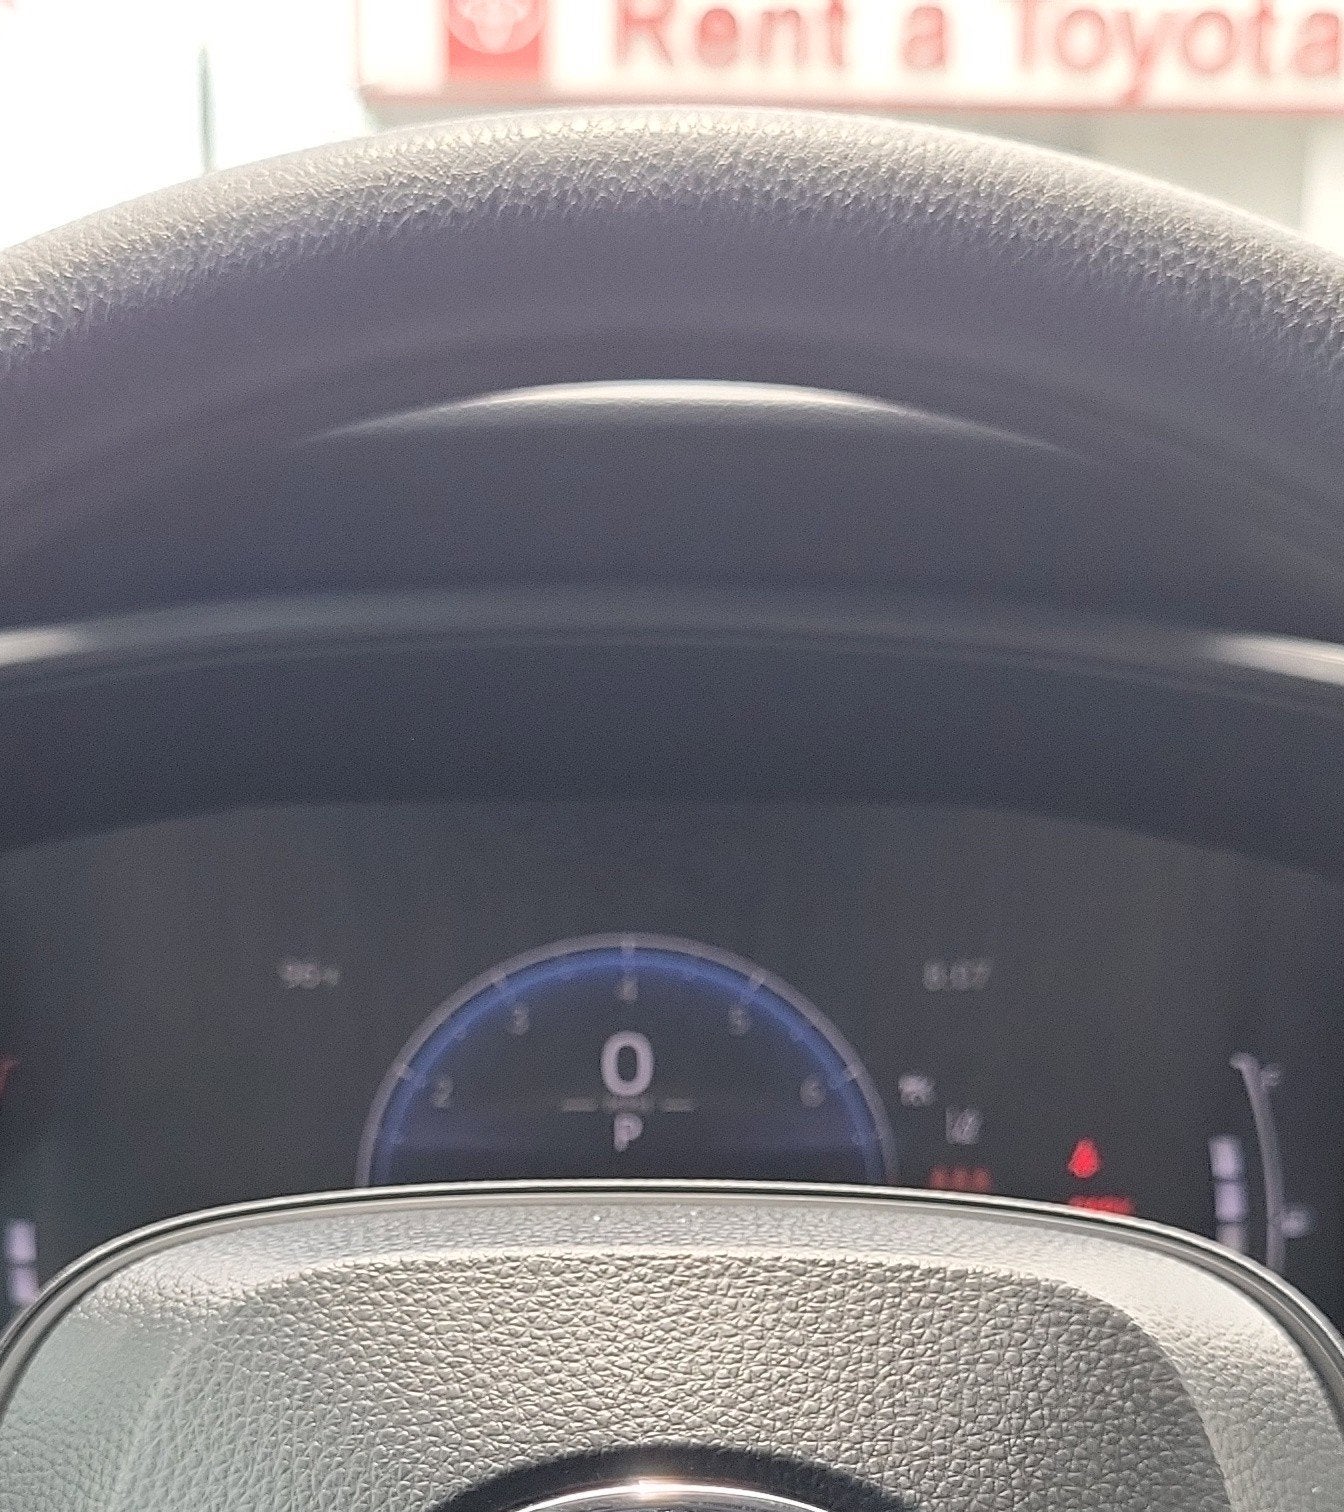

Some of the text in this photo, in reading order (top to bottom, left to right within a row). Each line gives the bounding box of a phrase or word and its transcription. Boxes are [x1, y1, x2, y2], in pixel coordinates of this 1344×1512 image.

[616, 0, 1342, 104] Rent a Toyota
[613, 1113, 643, 1152] P
